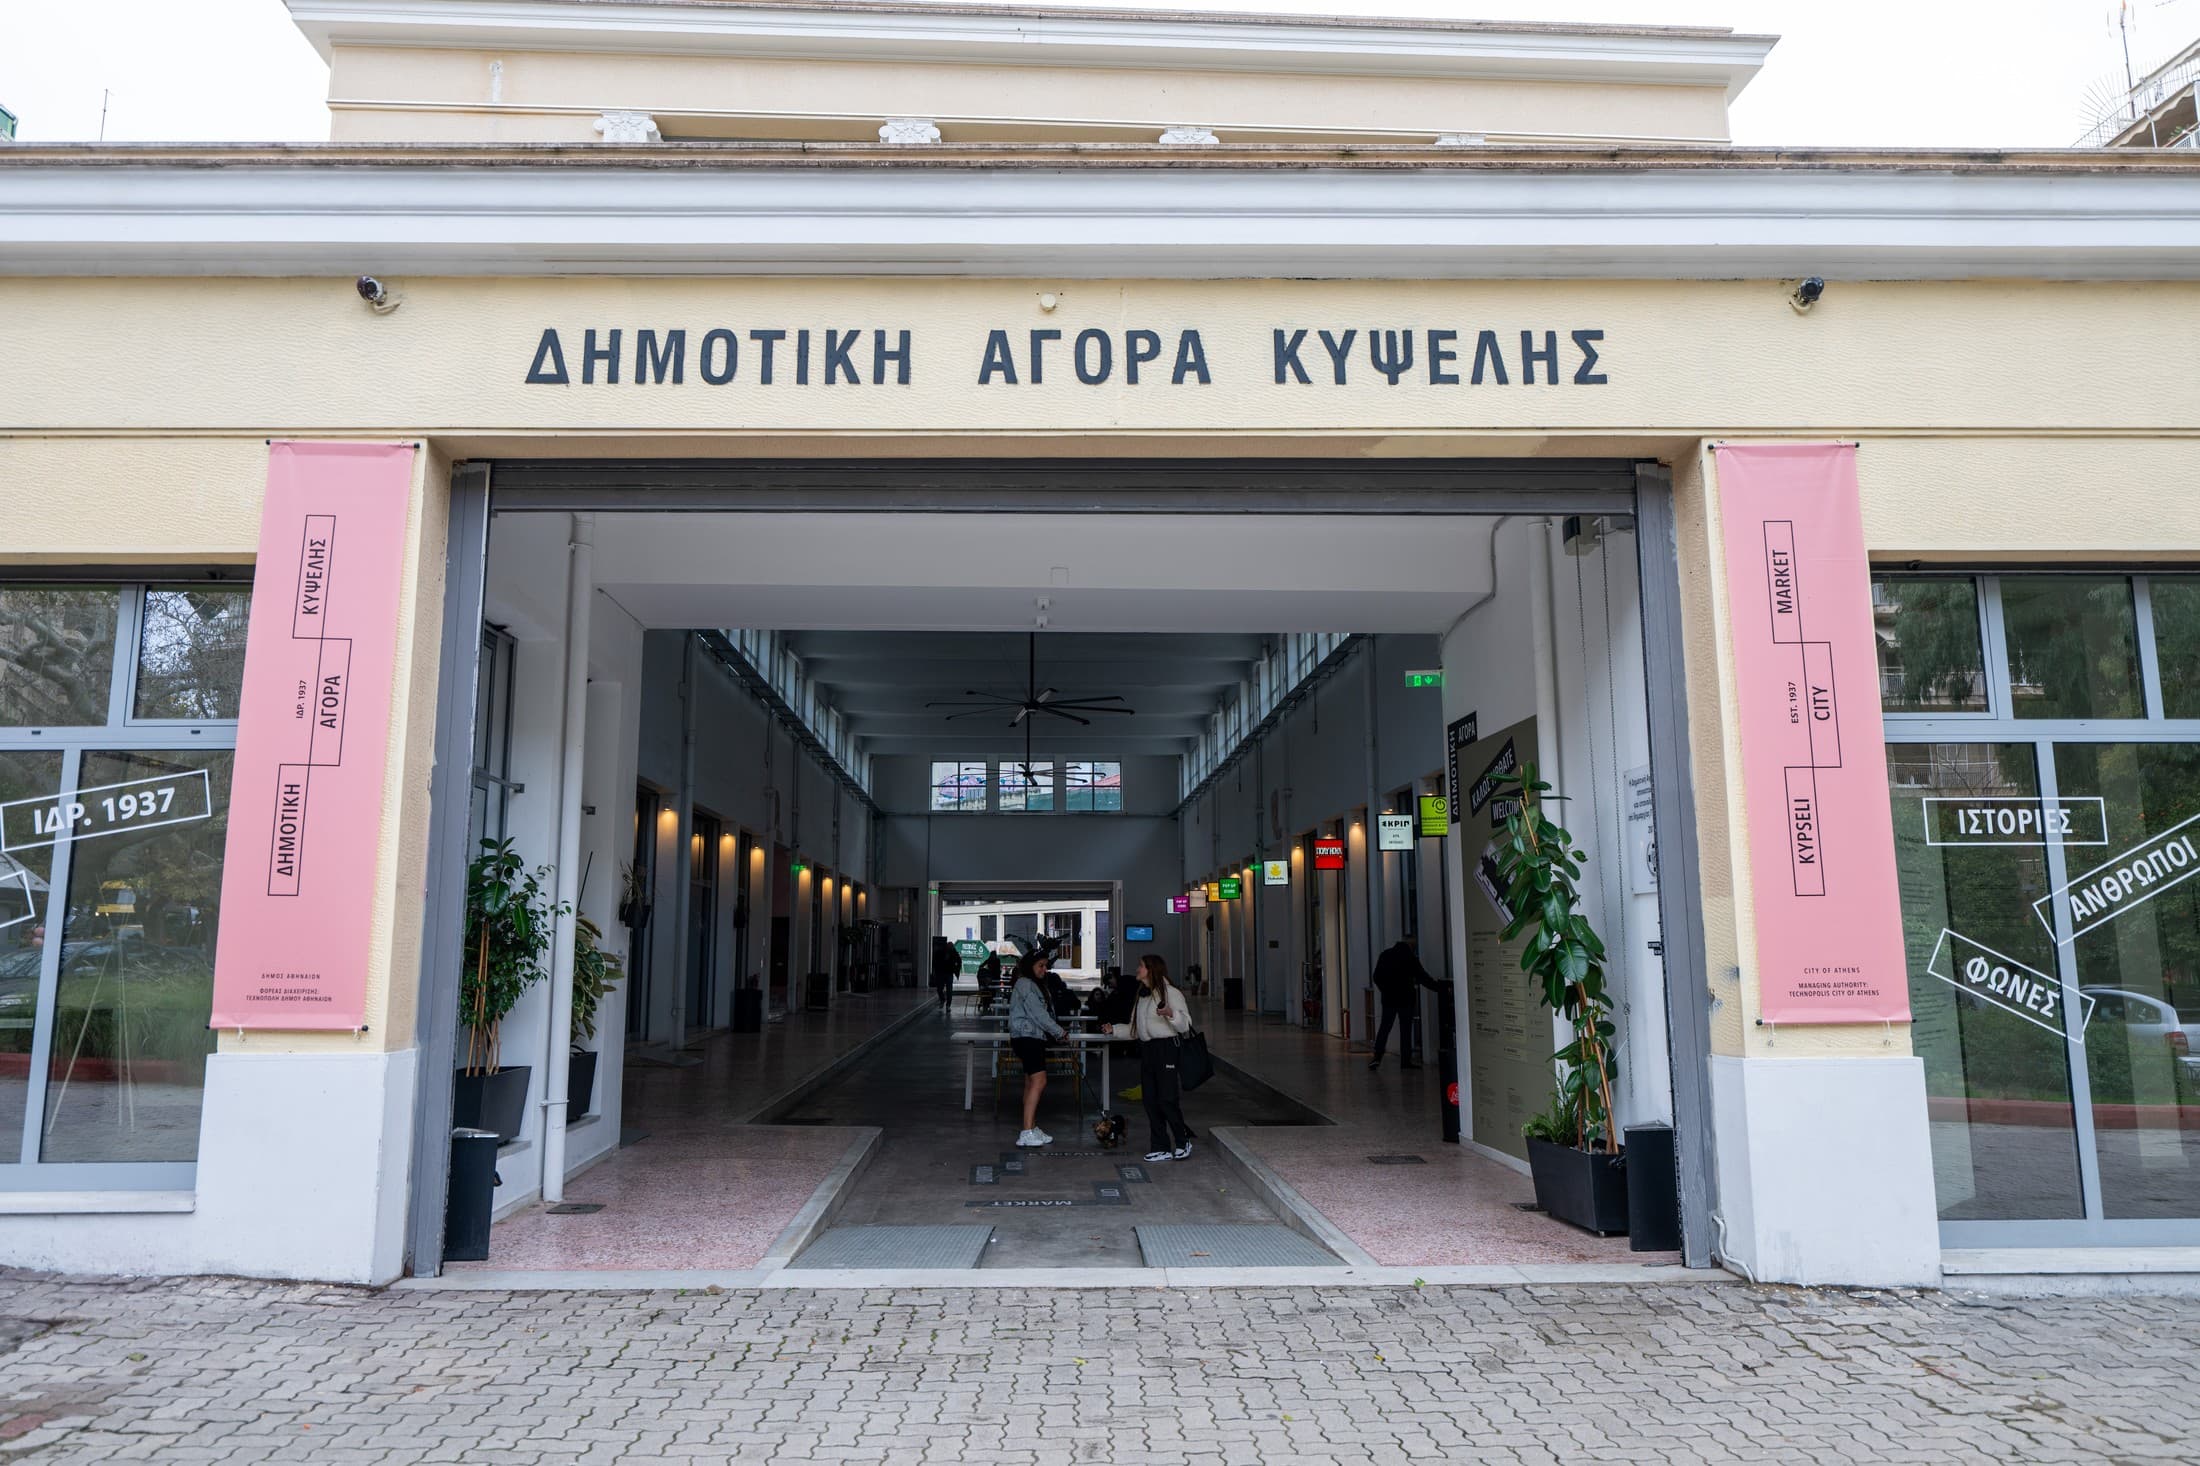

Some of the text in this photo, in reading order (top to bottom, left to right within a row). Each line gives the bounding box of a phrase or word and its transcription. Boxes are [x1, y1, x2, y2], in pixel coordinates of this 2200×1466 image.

[525, 328, 1608, 386] ΔΗΜΟΤΙΚΗ ΑΓΟΡΑ ΚΥΨΕΛΗΣ
[302, 538, 327, 616] ΚΥΨΕΛΗΣ
[1772, 549, 1793, 615] MARKET
[296, 679, 307, 719] ΙΔΡ. 1937
[320, 674, 341, 729] ΑΓΟΡΑ
[1788, 681, 1800, 724] EST. 1937
[1812, 685, 1831, 721] CITY
[1458, 721, 1476, 743] ΑΓΟΡΑ
[1449, 730, 1459, 816] ΔΗΜΟΤΙΚΗ
[34, 787, 176, 835] ΙΔΡ. 1937
[277, 784, 301, 877] ΔΗΜΟΤΙΚΗ
[1793, 797, 1816, 865] KYPSELI
[1958, 808, 2073, 835] ΙΣΤΟΡΙΕΣ
[2069, 835, 2199, 922] ΑΝΘΡΩΠΟΙ
[1966, 956, 2060, 1018] ΦΩΝΕΣ
